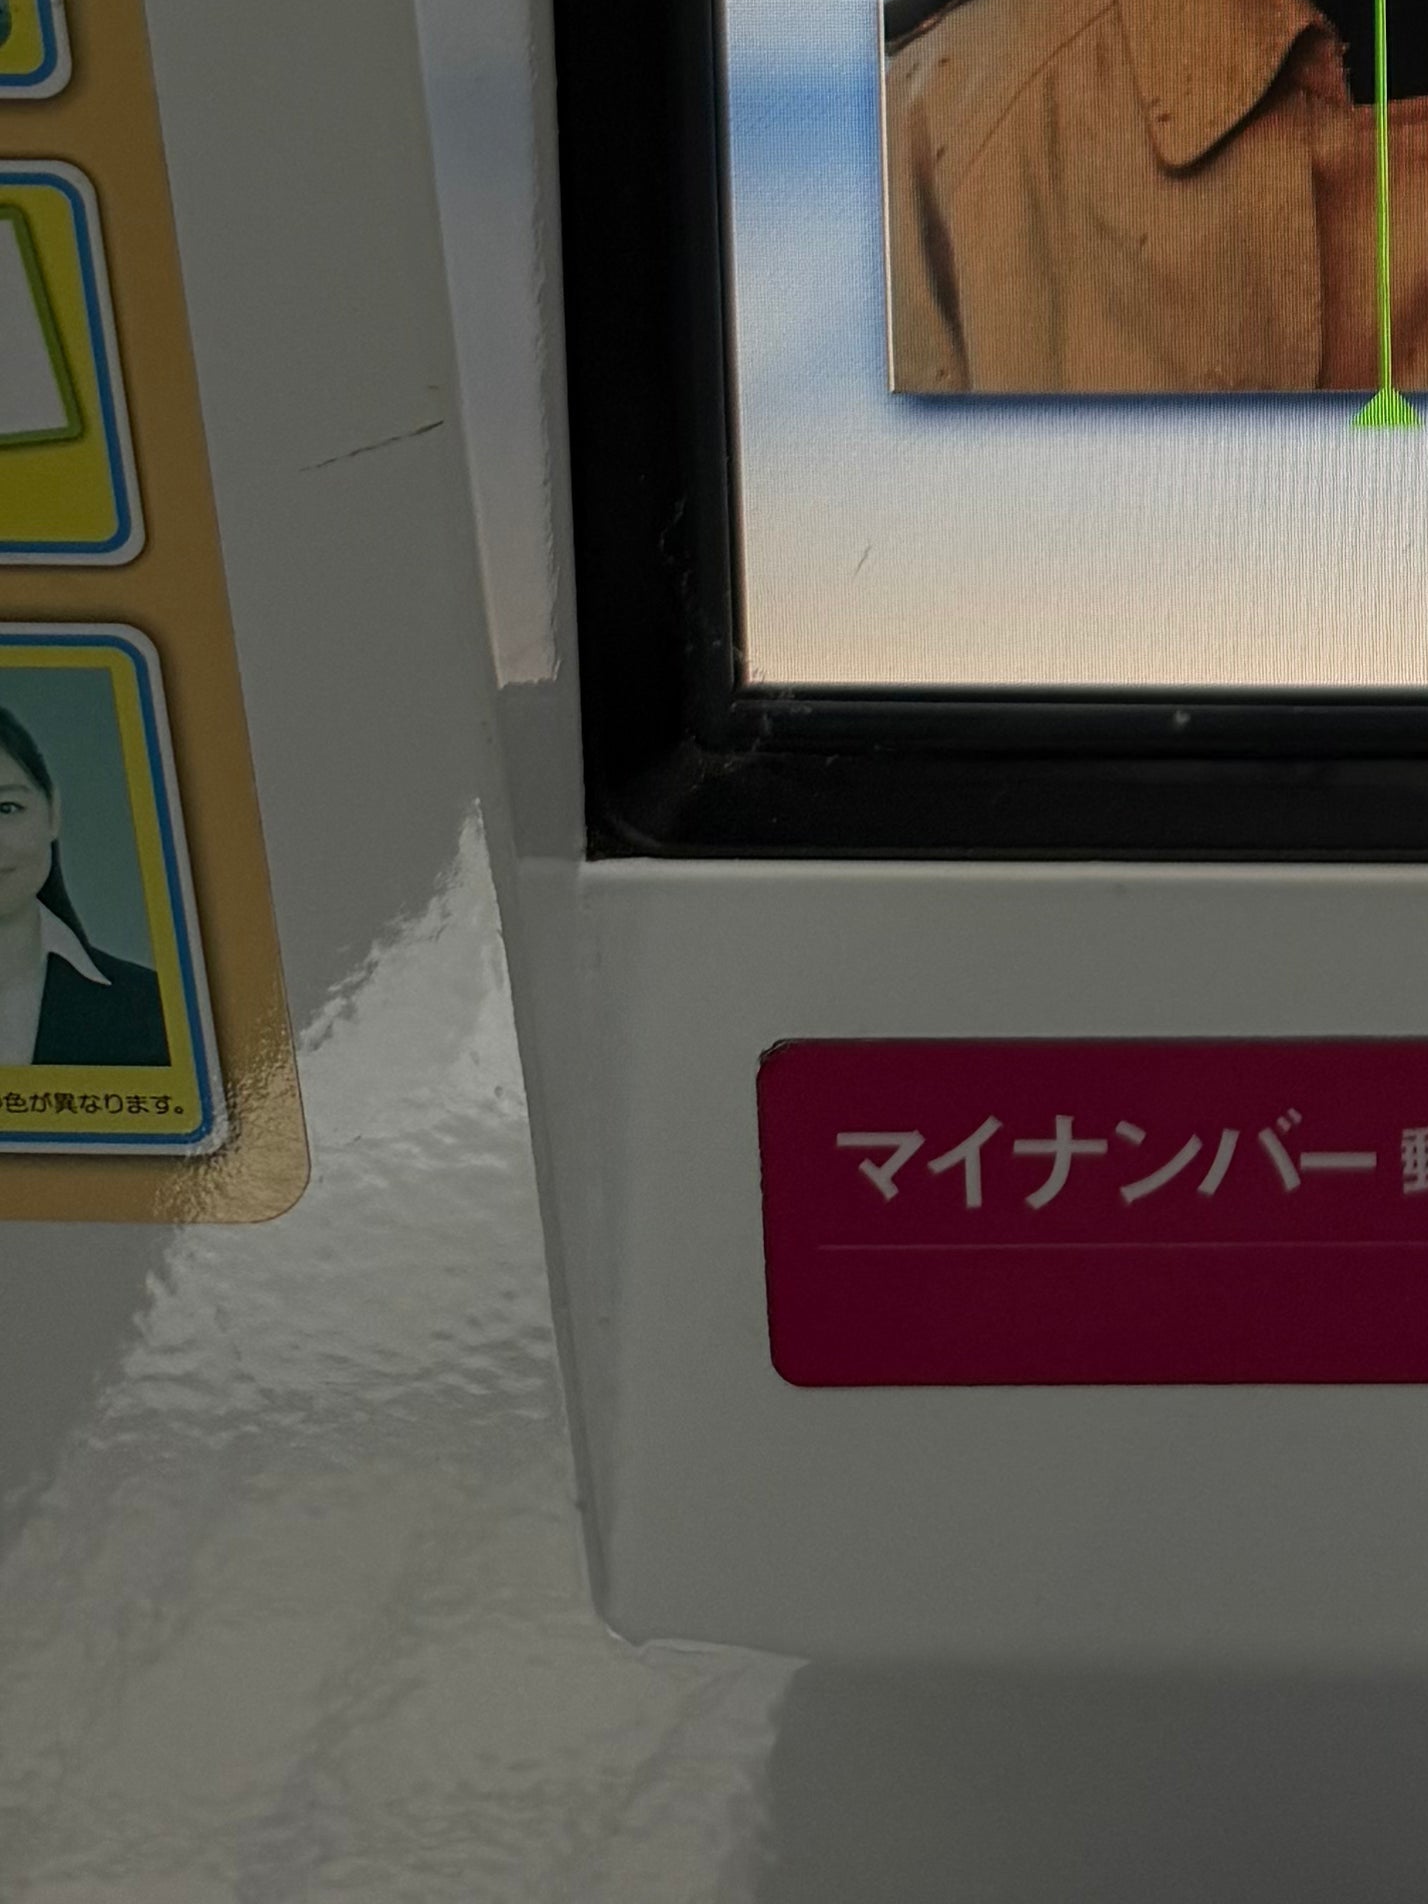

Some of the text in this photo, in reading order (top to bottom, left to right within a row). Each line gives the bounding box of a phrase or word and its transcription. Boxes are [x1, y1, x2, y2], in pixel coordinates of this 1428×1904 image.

[0, 1091, 185, 1116] 色が異なります。
